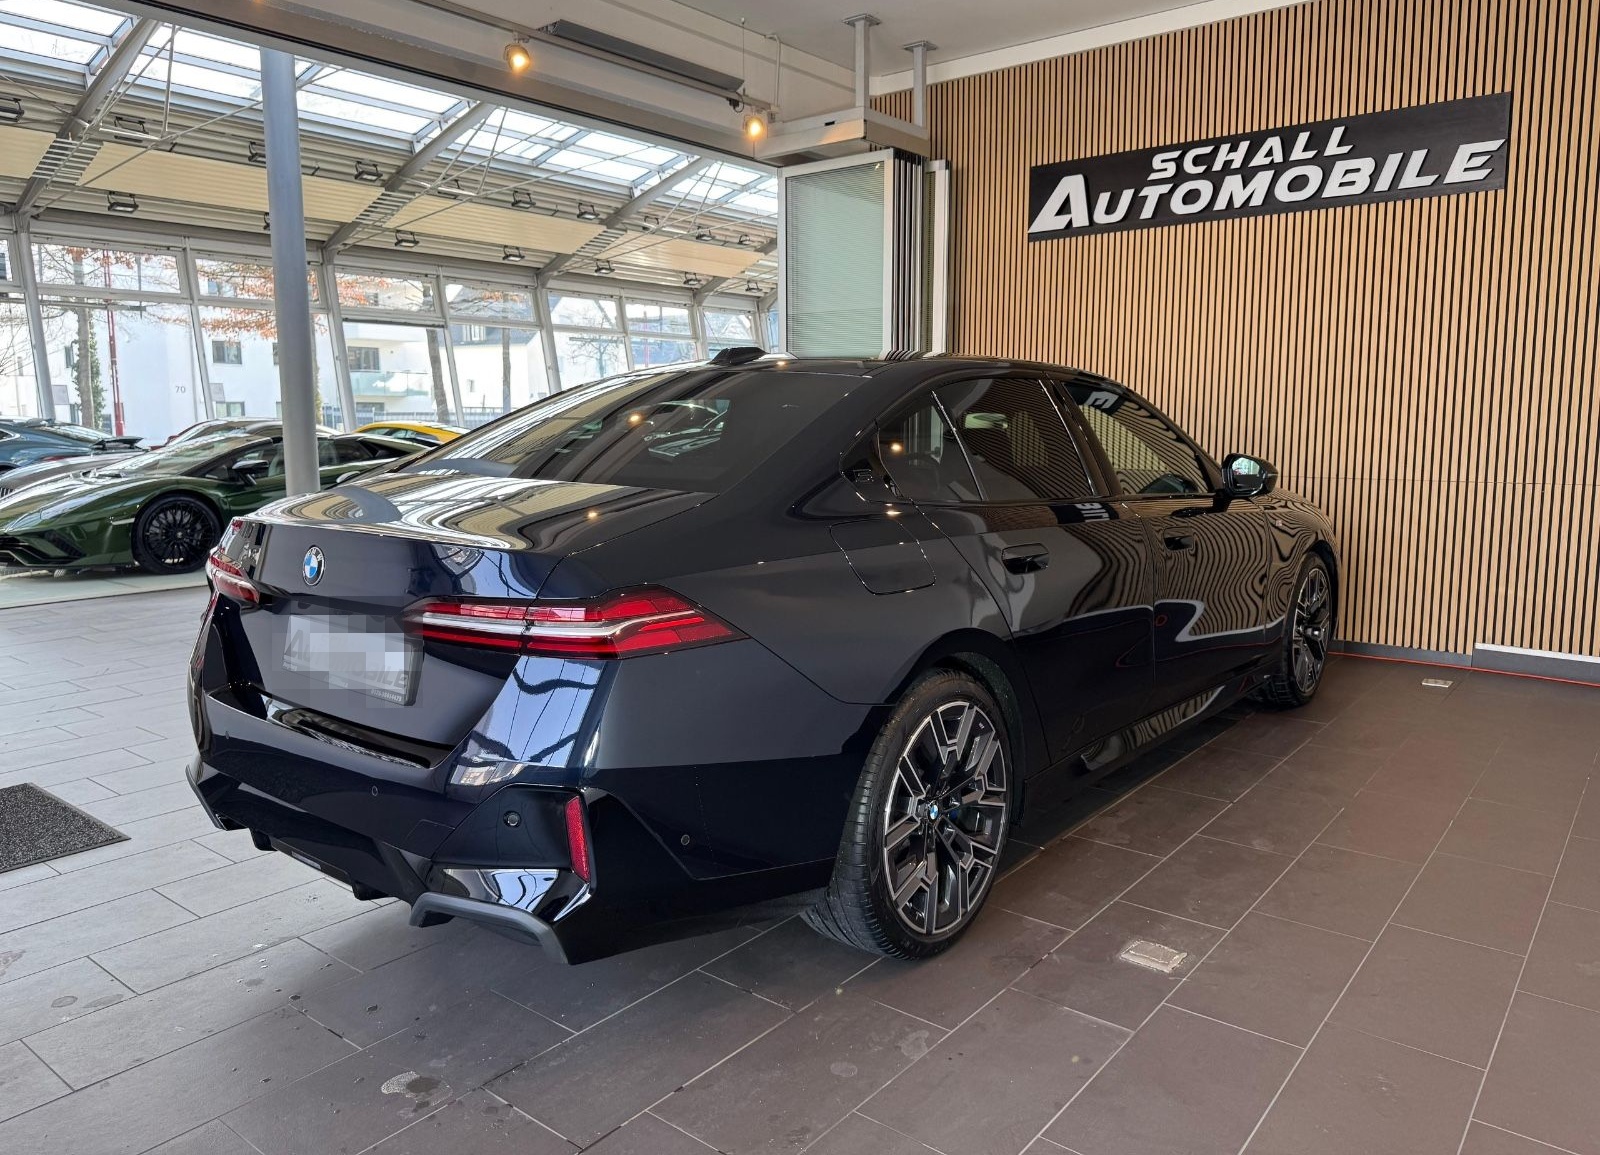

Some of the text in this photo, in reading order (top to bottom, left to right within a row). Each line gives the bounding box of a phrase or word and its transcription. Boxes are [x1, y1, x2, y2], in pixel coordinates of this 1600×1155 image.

[1147, 125, 1354, 181] SCHALL
[1028, 139, 1506, 234] AUTOMOBILE
[175, 385, 186, 394] 70
